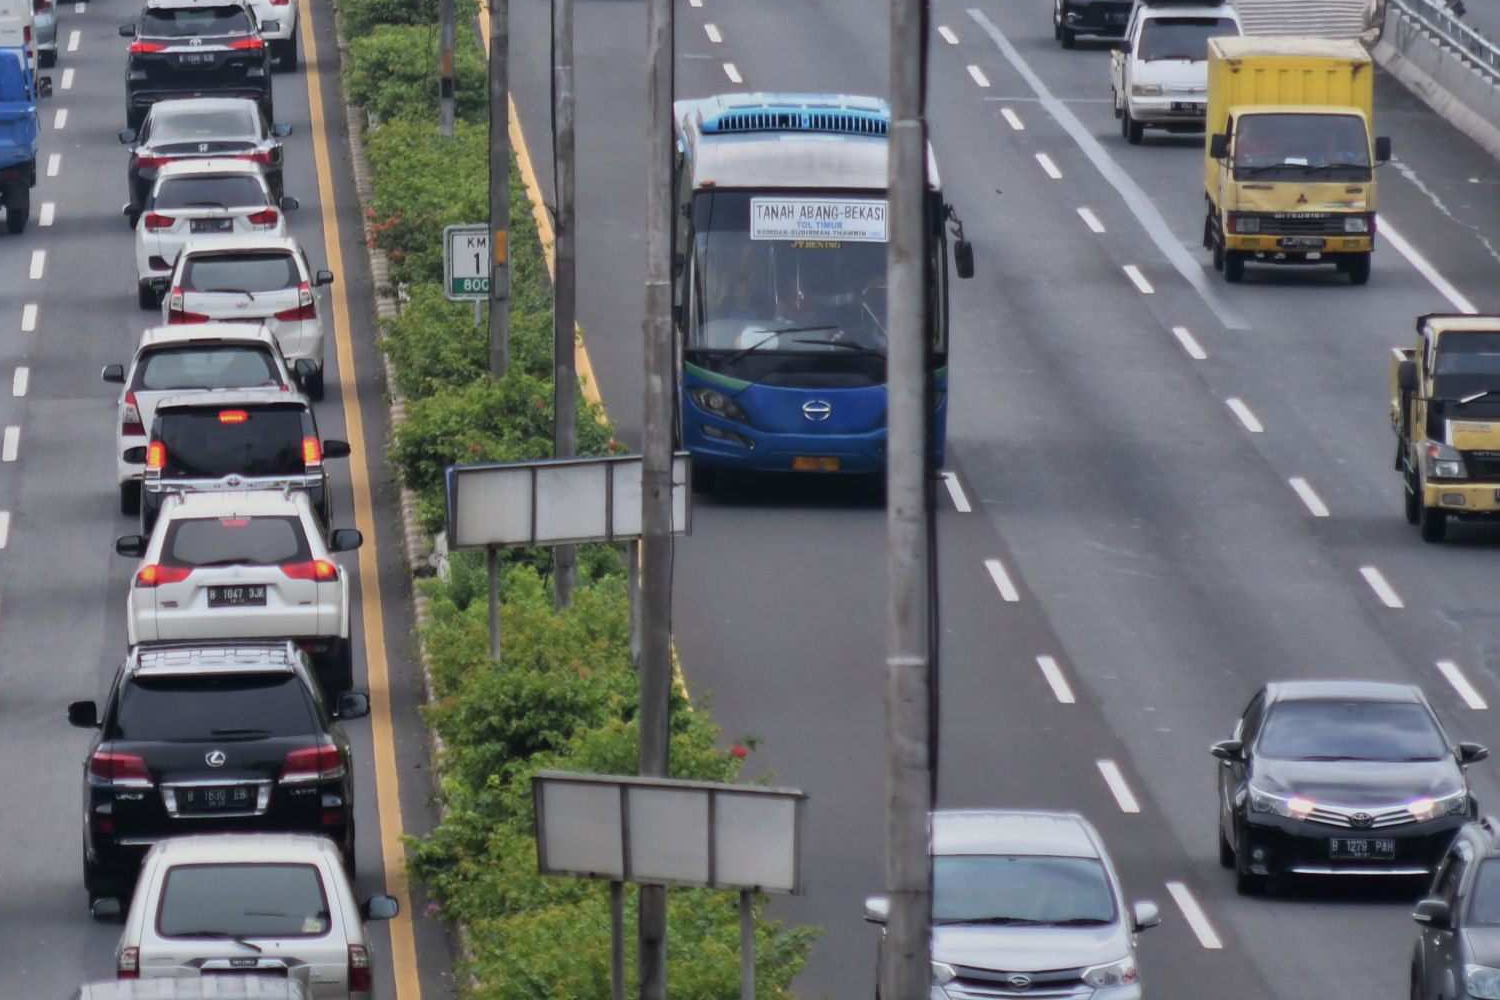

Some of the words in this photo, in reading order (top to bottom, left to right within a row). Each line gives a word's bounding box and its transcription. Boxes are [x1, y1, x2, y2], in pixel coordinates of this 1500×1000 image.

[756, 204, 795, 220] TANAH
[800, 205, 885, 221] ABANG-BEKASI
[796, 221, 813, 229] TOL
[816, 221, 843, 229] TIMUR
[467, 237, 487, 248] KM
[463, 278, 489, 291] 800
[209, 590, 216, 600] B
[223, 588, 243, 599] 1047
[1332, 840, 1338, 852] B
[1347, 840, 1367, 852] 1279
[1376, 841, 1393, 852] PAH
